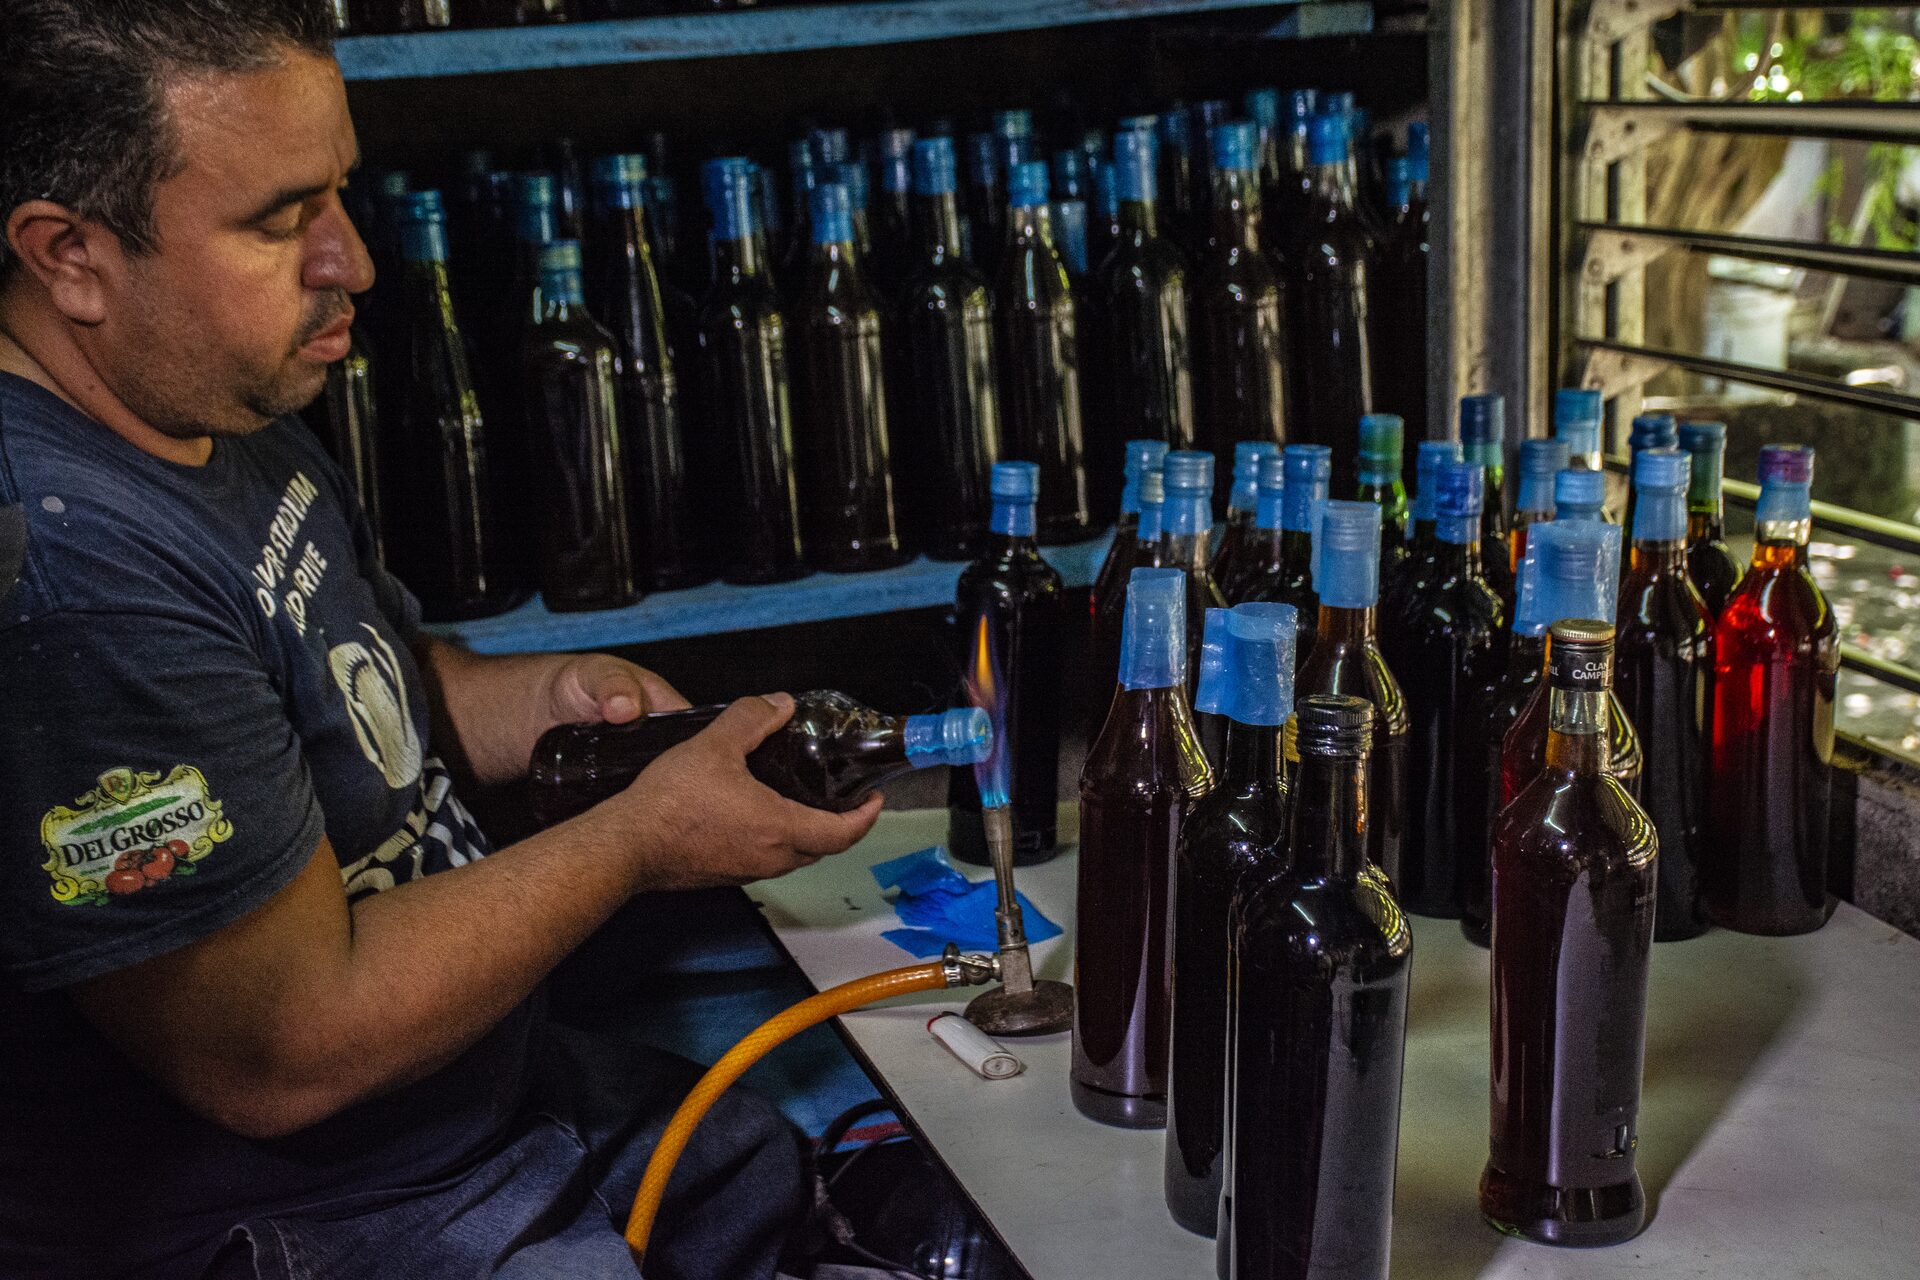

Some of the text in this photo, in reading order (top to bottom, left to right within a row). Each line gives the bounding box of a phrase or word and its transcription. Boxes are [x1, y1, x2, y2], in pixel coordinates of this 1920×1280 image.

[269, 469, 319, 560] STADIUM
[1584, 661, 1608, 672] CLAN
[60, 800, 205, 868] DELGROSSO
